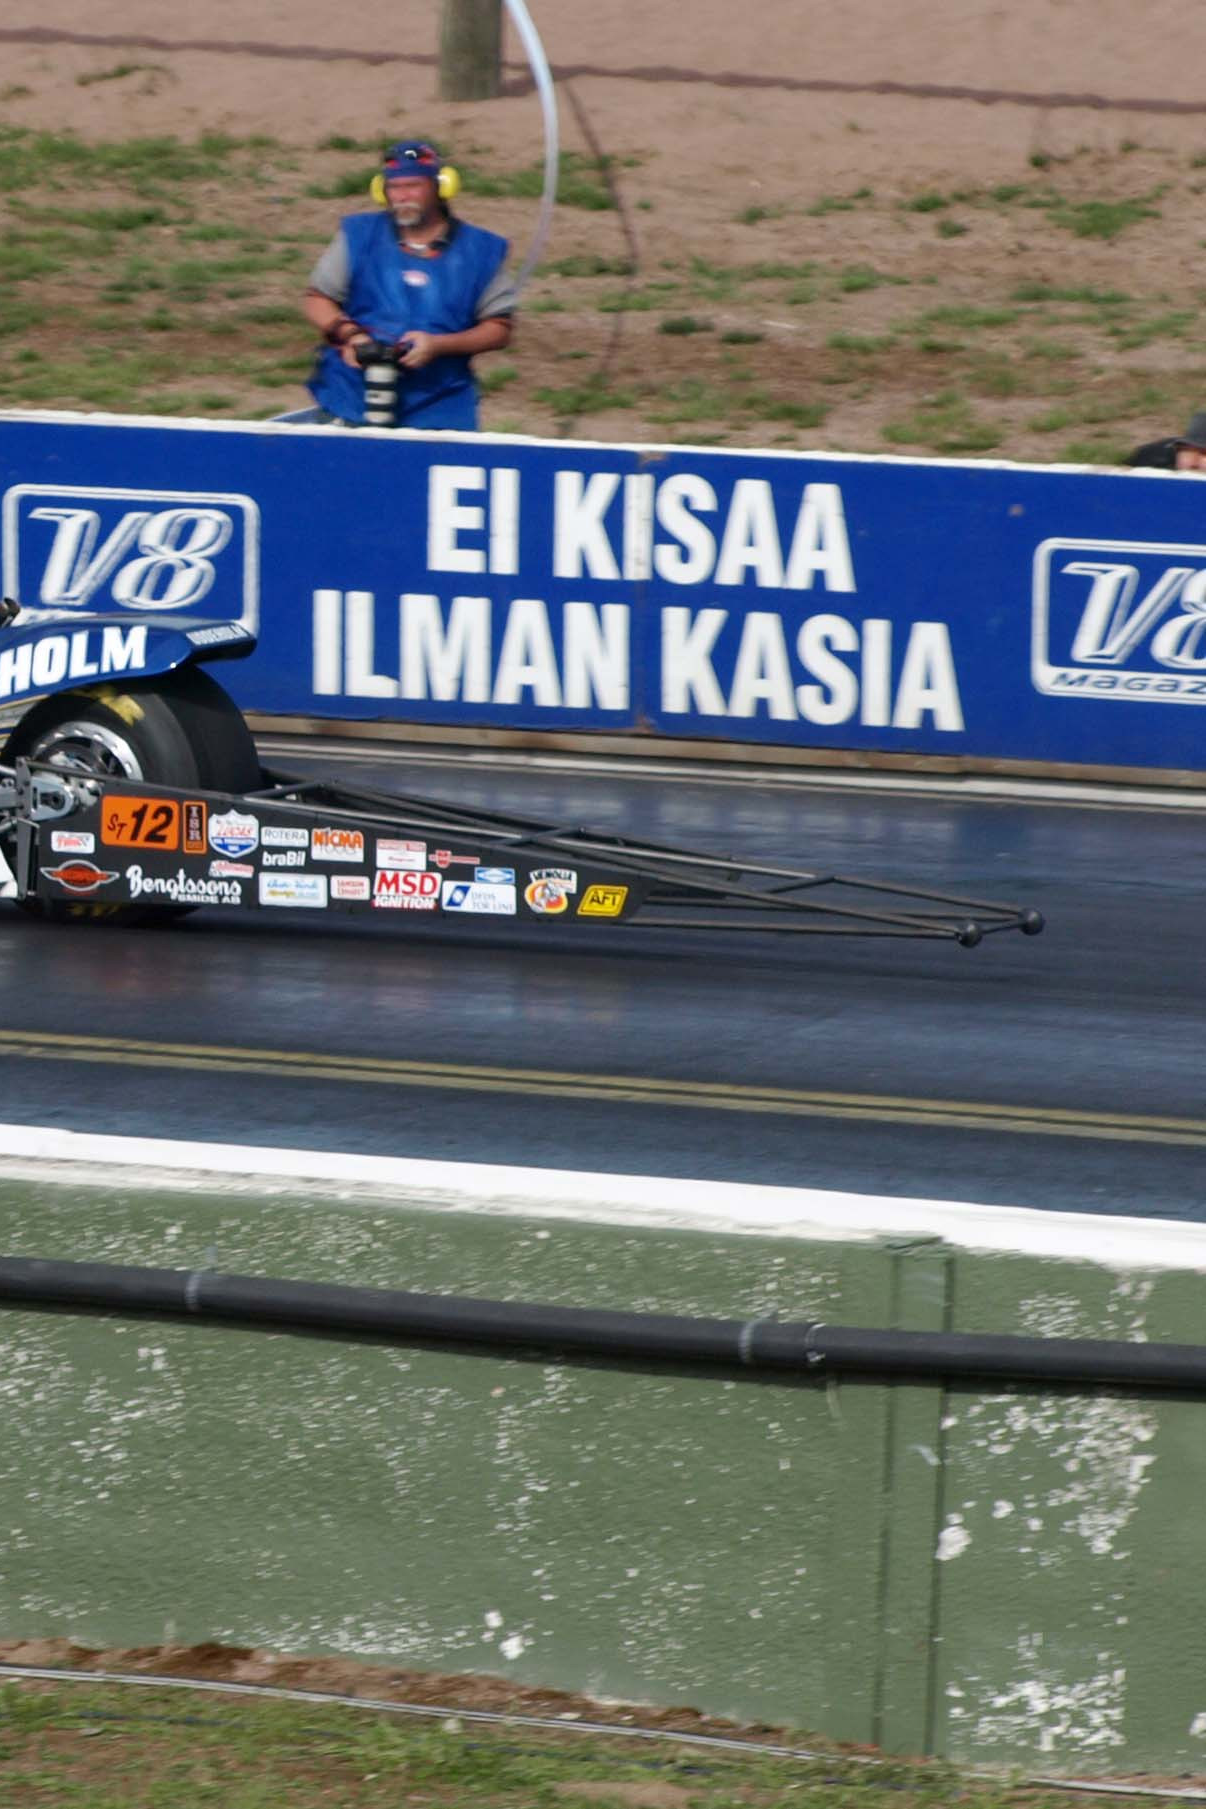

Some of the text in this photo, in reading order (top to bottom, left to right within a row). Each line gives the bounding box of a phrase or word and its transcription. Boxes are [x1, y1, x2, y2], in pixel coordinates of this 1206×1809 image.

[428, 464, 857, 594] EI KISAA
[27, 507, 234, 611] V8
[312, 589, 966, 732] ILMAN KASIA
[128, 803, 174, 844] 12
[126, 864, 242, 899] Bengtssons
[377, 871, 438, 896] MSD
[374, 895, 436, 910] IGNITION
